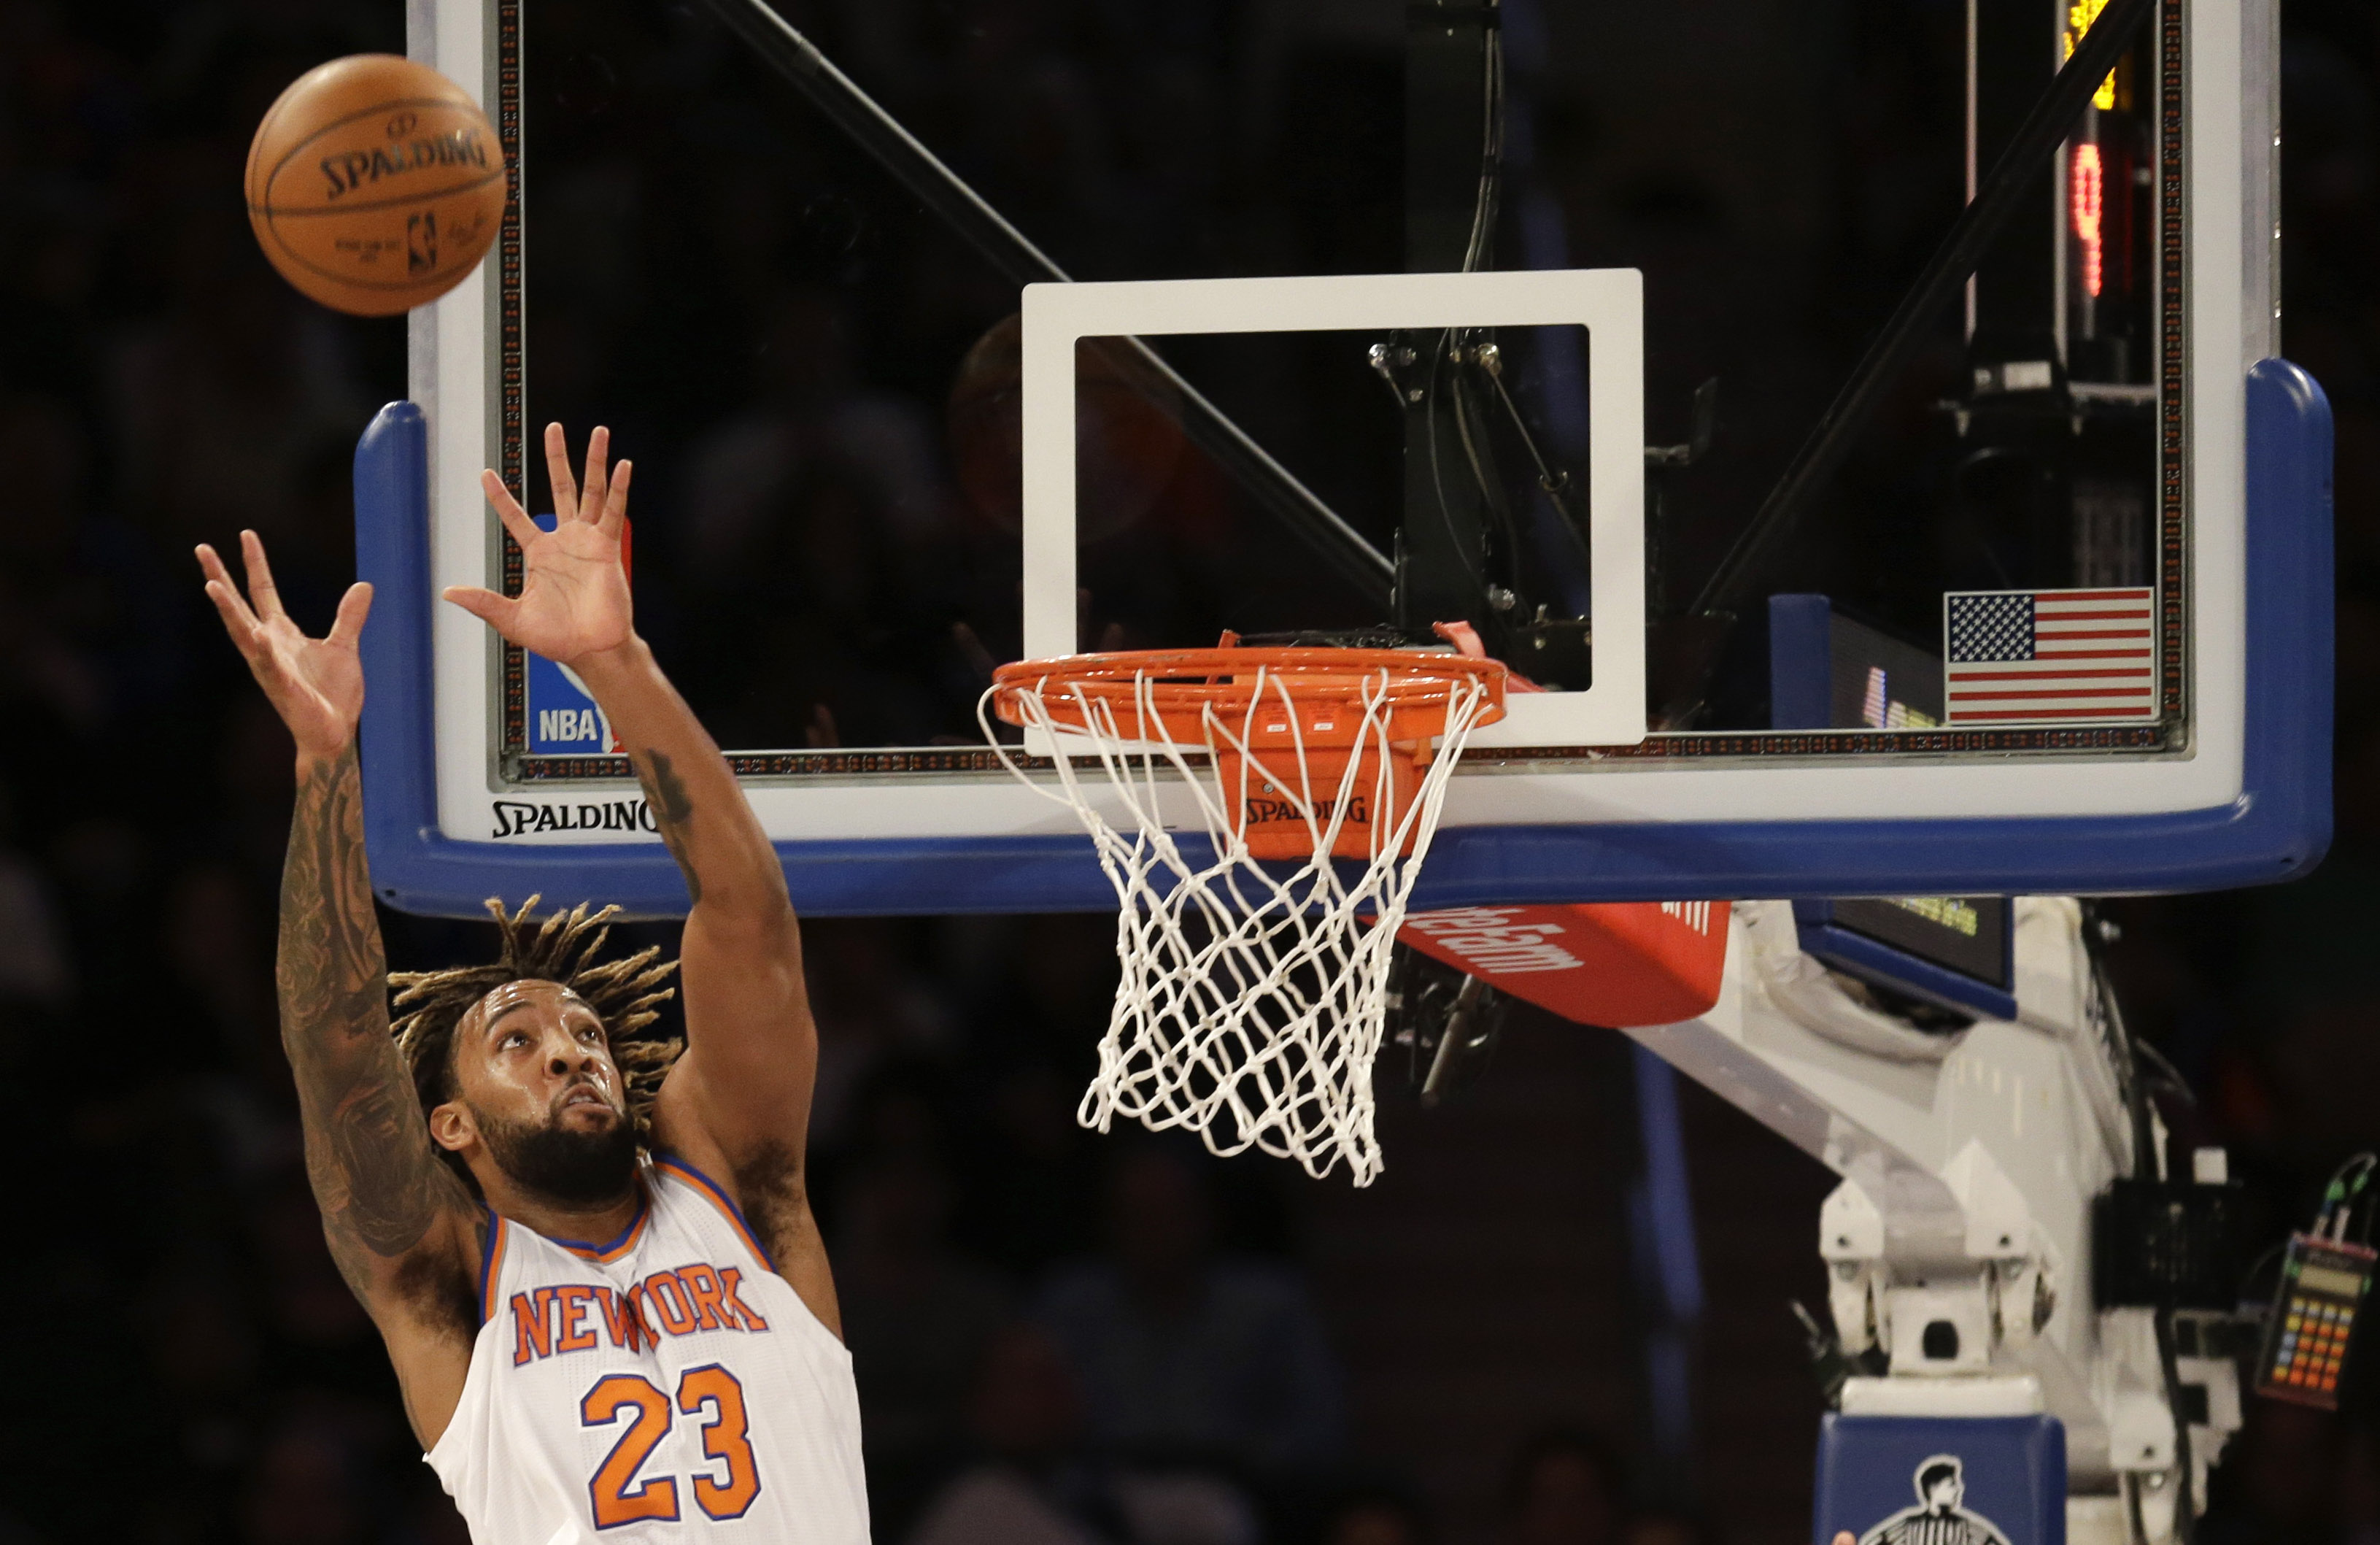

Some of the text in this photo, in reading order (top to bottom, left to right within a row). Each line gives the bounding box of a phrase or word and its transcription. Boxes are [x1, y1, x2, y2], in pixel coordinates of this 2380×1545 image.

[320, 128, 488, 201] SPALDING
[538, 709, 598, 743] NBA
[510, 1283, 641, 1369] NEW
[580, 1362, 762, 1531] 23
